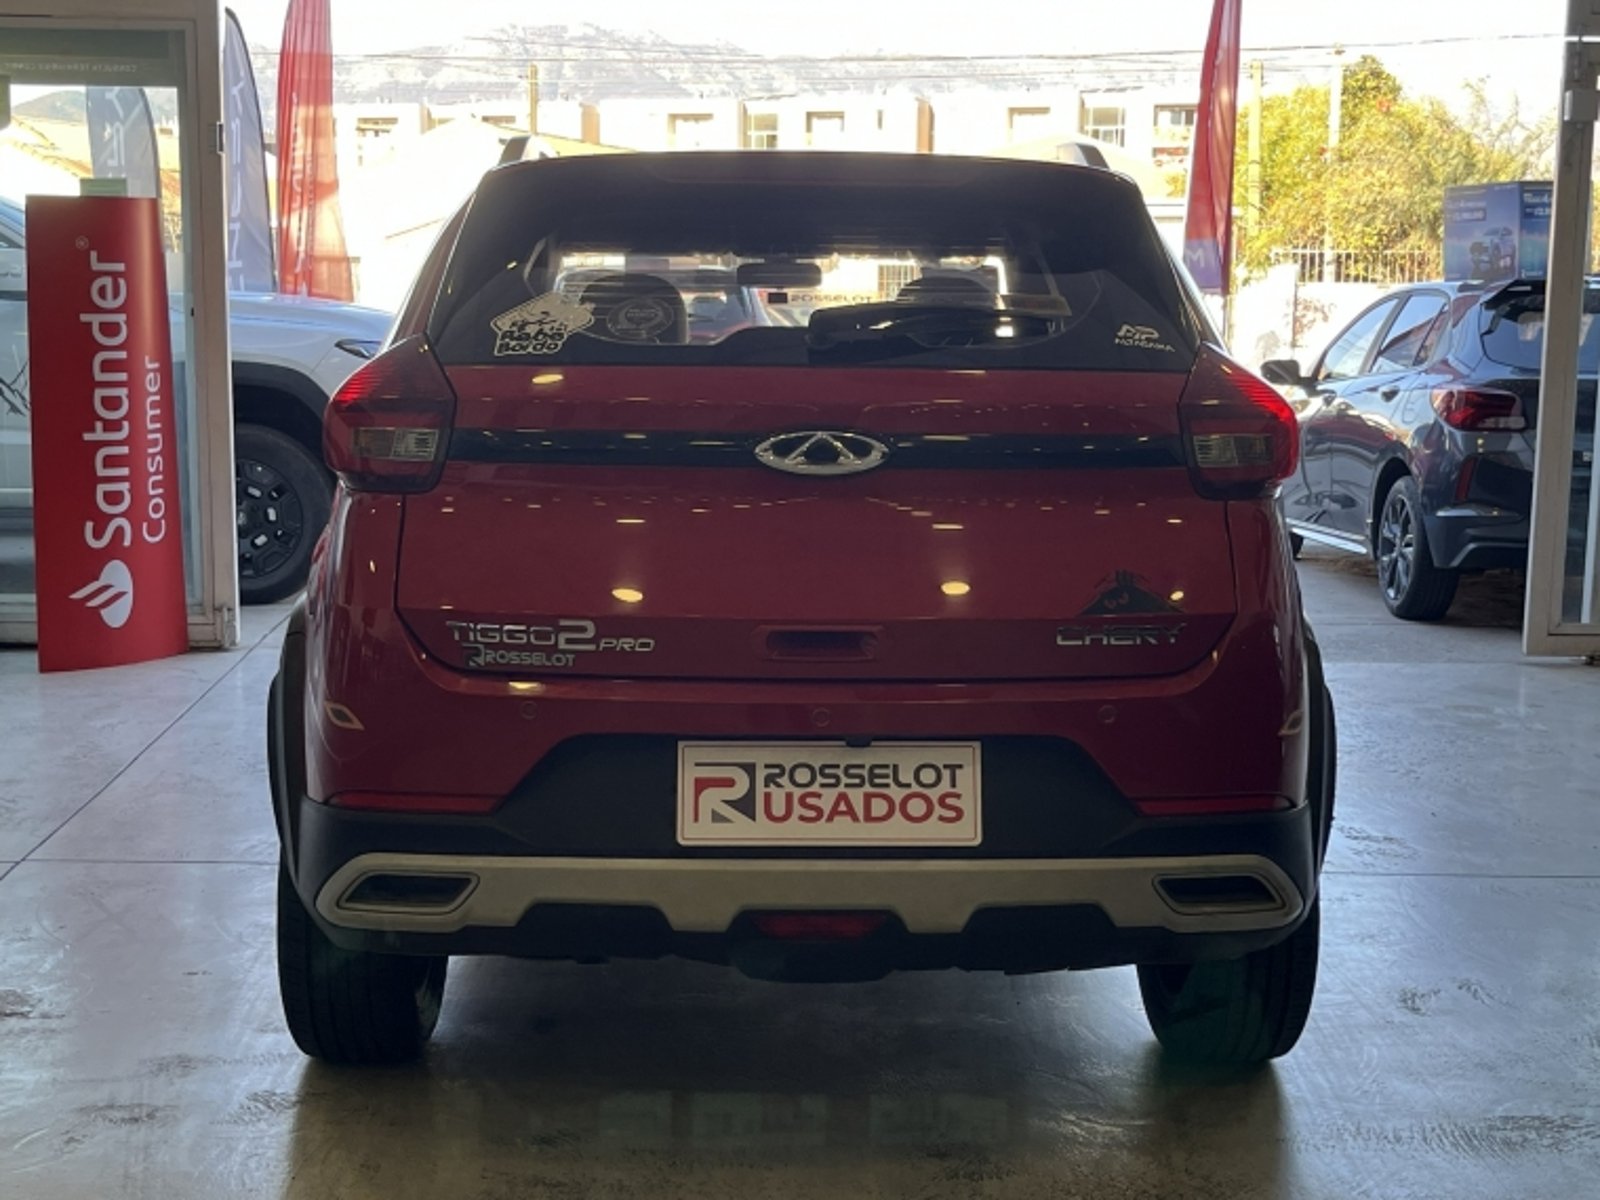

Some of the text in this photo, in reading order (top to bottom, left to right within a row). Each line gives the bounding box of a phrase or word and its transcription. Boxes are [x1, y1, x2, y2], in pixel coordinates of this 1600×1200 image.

[79, 250, 132, 549] Santander
[142, 355, 166, 544] Consumer
[1056, 622, 1188, 646] CHERY
[486, 649, 576, 668] ROSSELOT
[763, 762, 965, 789] ROSSELOT
[763, 790, 966, 824] USADOS
